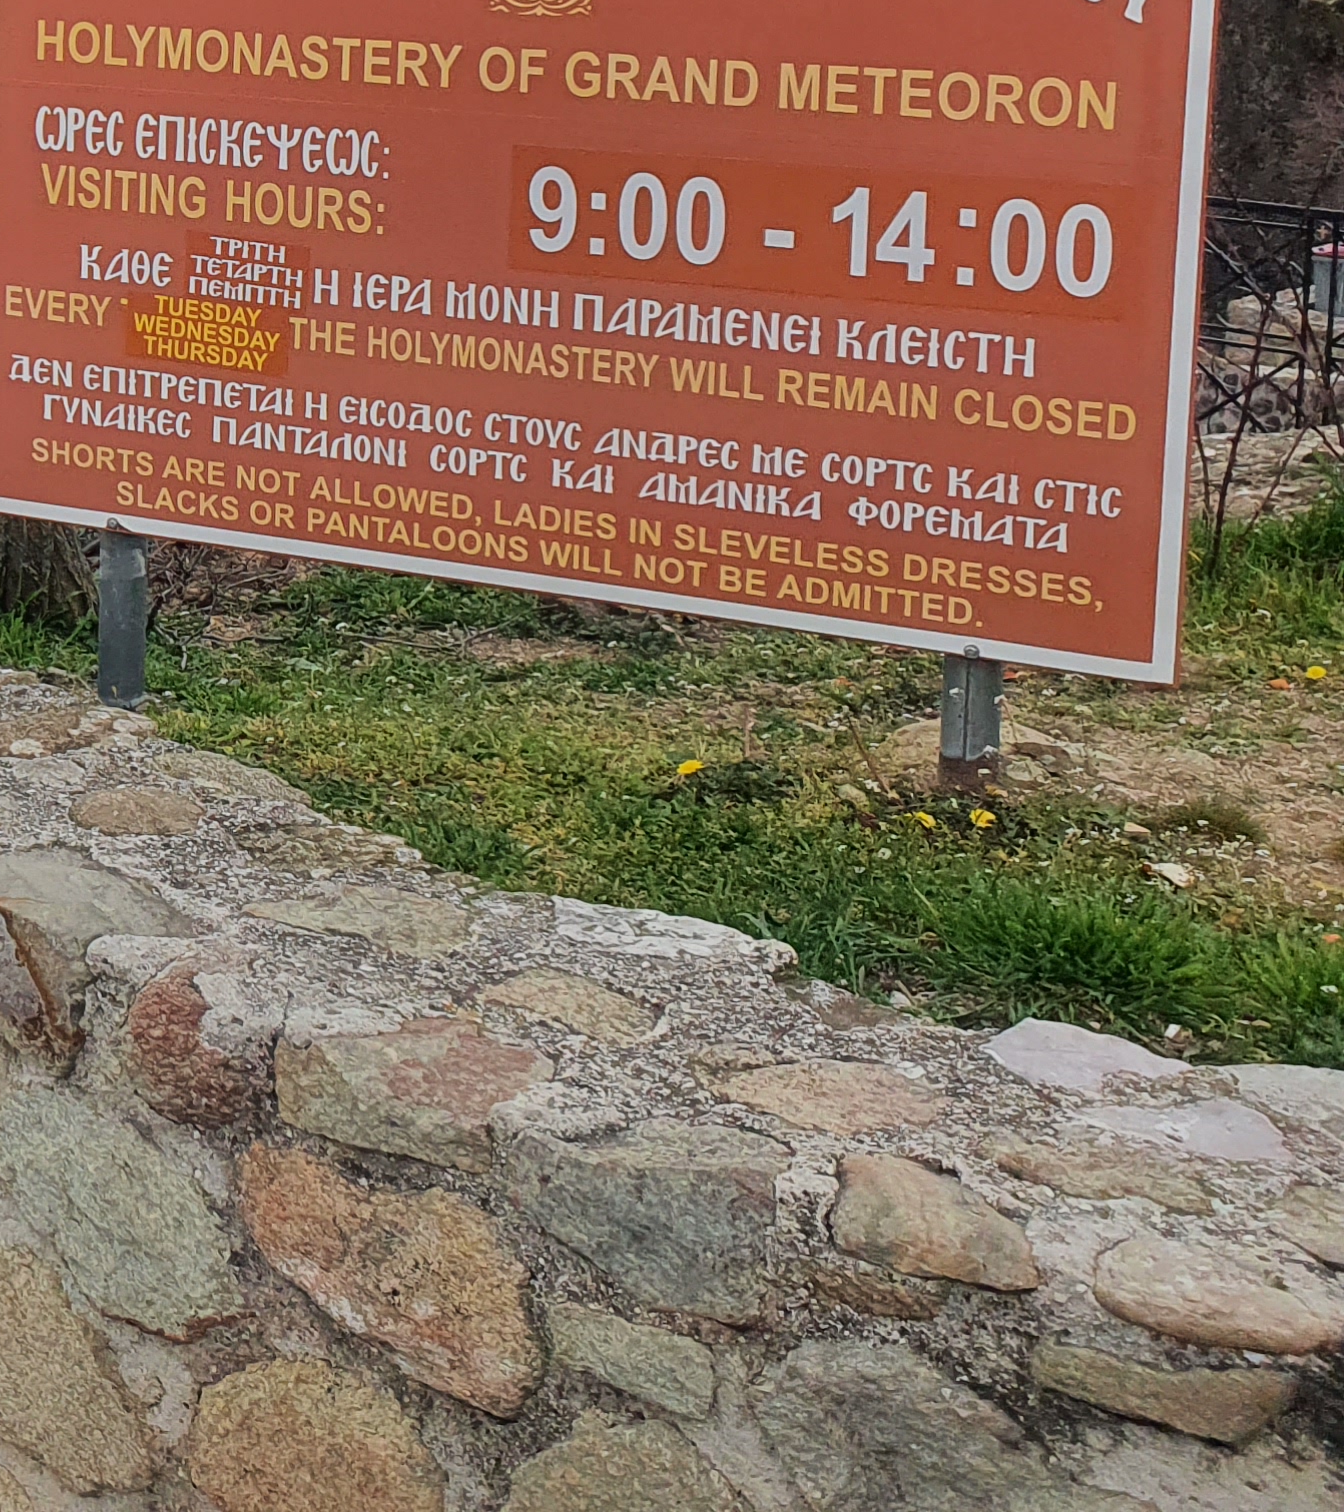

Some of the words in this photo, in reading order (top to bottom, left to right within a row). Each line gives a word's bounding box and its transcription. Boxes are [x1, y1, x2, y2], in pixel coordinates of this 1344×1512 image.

[36, 19, 463, 88] HOLYMONASTERY
[479, 46, 547, 93] OF
[565, 51, 759, 107] GRAND
[778, 62, 1117, 130] METEORON
[41, 162, 206, 219] VISITING
[225, 179, 385, 235] HOURS:
[528, 165, 726, 265] 9:00
[763, 228, 795, 249] -
[832, 186, 1113, 298] 14:00
[5, 284, 112, 327] EVERY
[133, 312, 281, 352] WEDNESDAY
[288, 316, 356, 356] THE
[367, 325, 660, 387] HOLYMONASTERY
[669, 357, 764, 401] WILL
[777, 368, 938, 420] REMAIN
[954, 388, 1137, 441] CLOSED
[143, 334, 268, 372] THURSDAY
[154, 294, 262, 328] TUESDAY
[31, 437, 154, 476] SHORTS
[161, 455, 225, 487] ARE
[236, 464, 301, 497] NOT
[309, 475, 482, 527] ALLOWED,
[494, 499, 617, 540] LADIES
[629, 517, 662, 547] IN
[673, 524, 889, 577] SLEVELESS
[903, 553, 1103, 612] DRESSES,
[116, 480, 239, 521] SLACKS
[249, 500, 295, 530] OR
[307, 507, 529, 562] PANTALOONS
[539, 539, 623, 577] WILL
[634, 553, 708, 587] NOT
[719, 564, 767, 597] BE
[776, 574, 983, 628] ADMITTED.
